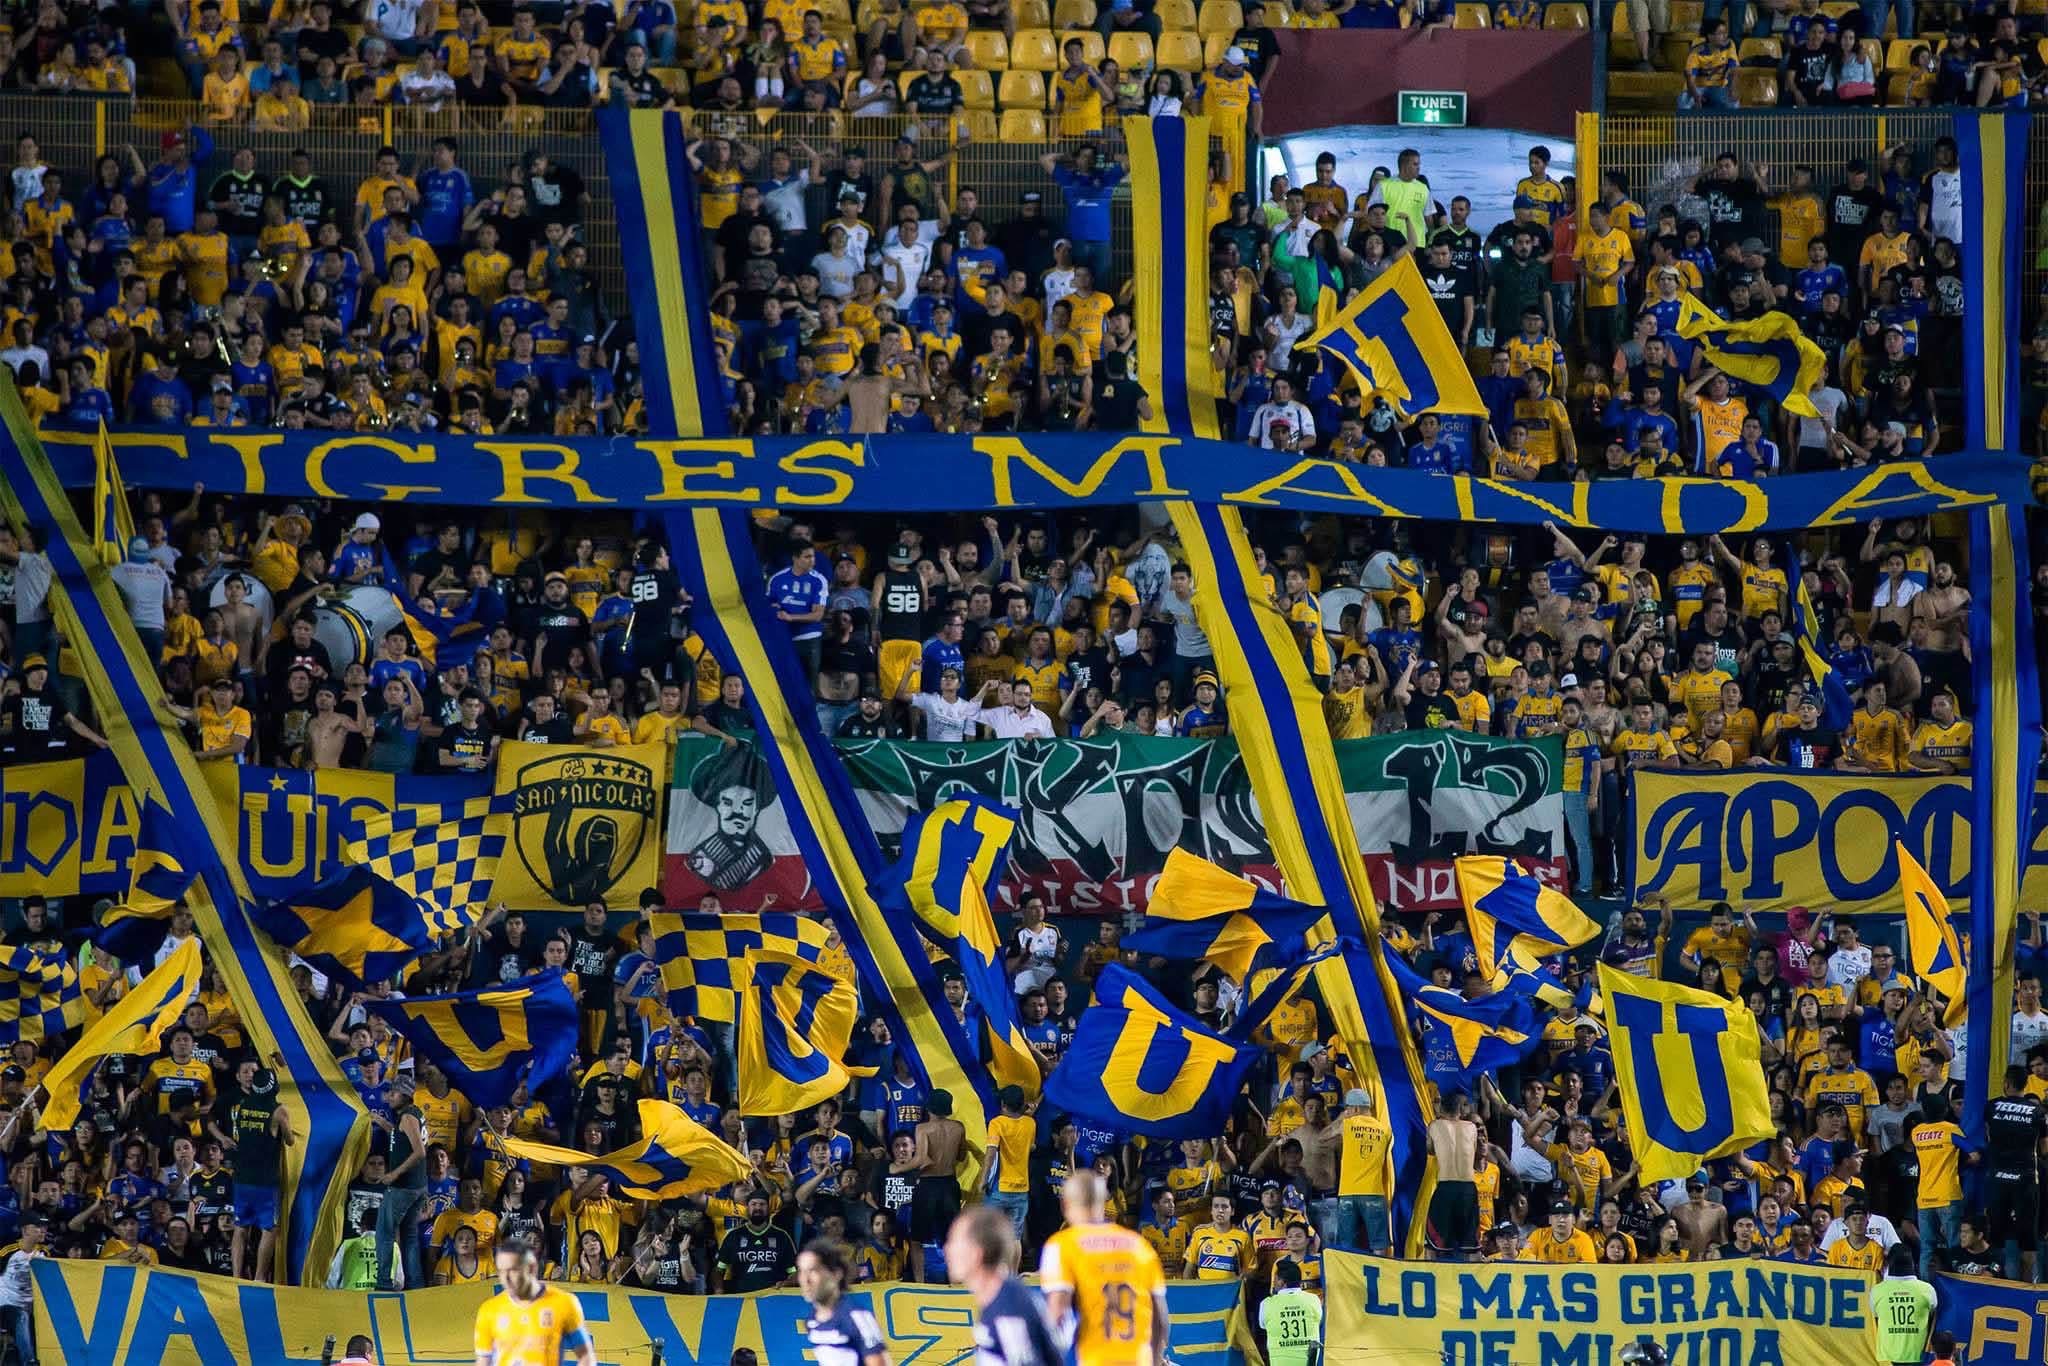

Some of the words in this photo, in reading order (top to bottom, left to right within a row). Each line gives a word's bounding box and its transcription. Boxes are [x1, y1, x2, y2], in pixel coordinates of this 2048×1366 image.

[1410, 96, 1457, 110] TUNEL
[1423, 109, 1441, 123] 21
[1431, 290, 1457, 300] adidas
[40, 431, 865, 504] TIGRES
[973, 436, 1998, 535] MANDA
[631, 580, 659, 603] 98
[887, 593, 921, 614] 98
[515, 784, 556, 814] SAN
[571, 782, 655, 812] NICOLAS
[1100, 984, 1238, 1122] U
[1612, 991, 1734, 1155] U
[1995, 1100, 2036, 1117] TECATE
[2002, 1112, 2033, 1124] AFIRME
[1915, 1130, 1944, 1142] TECATE
[885, 1177, 904, 1186] THE
[359, 1251, 377, 1259] STA
[737, 1250, 778, 1262] TIGRES
[1362, 1265, 1437, 1319] LO
[1457, 1271, 1599, 1323] MAS
[1619, 1266, 1867, 1330] GRANDE
[1888, 1295, 1915, 1304] STAFF
[1102, 1282, 1137, 1341] 19
[1279, 1309, 1306, 1319] STAFF
[1890, 1304, 1916, 1326] 102
[1280, 1318, 1308, 1339] 331
[1440, 1329, 1517, 1366] DE
[1537, 1330, 1614, 1366] MI
